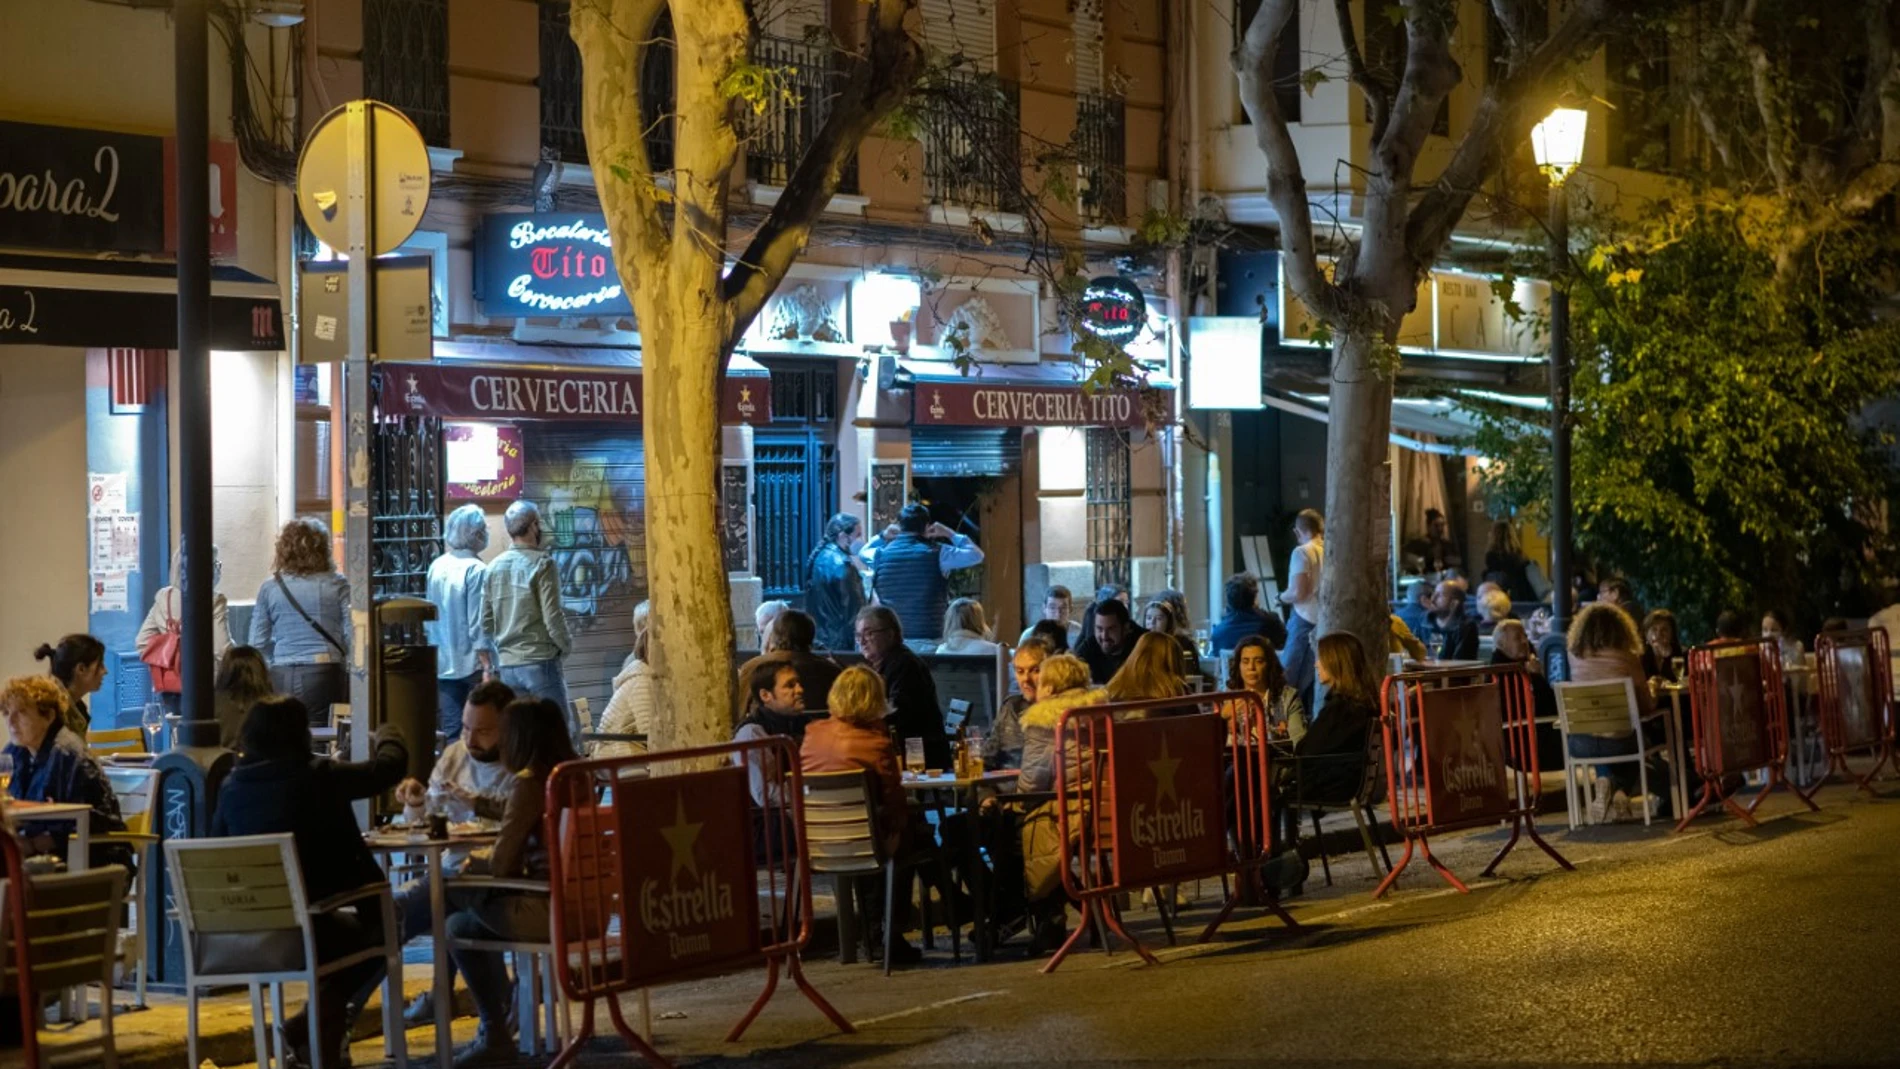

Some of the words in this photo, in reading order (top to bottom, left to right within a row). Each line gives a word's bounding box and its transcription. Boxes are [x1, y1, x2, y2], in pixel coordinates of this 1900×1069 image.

[531, 246, 606, 279] Tito
[19, 290, 38, 334] 2
[470, 375, 640, 415] CERVECERIA
[973, 390, 1086, 421] CERVECERIA
[1089, 394, 1131, 421] TITO
[1443, 753, 1497, 793] Estrella
[1130, 801, 1205, 848] Estrella
[1152, 846, 1187, 869] Damm
[639, 871, 734, 935] Estrella
[668, 932, 711, 960] Damm
